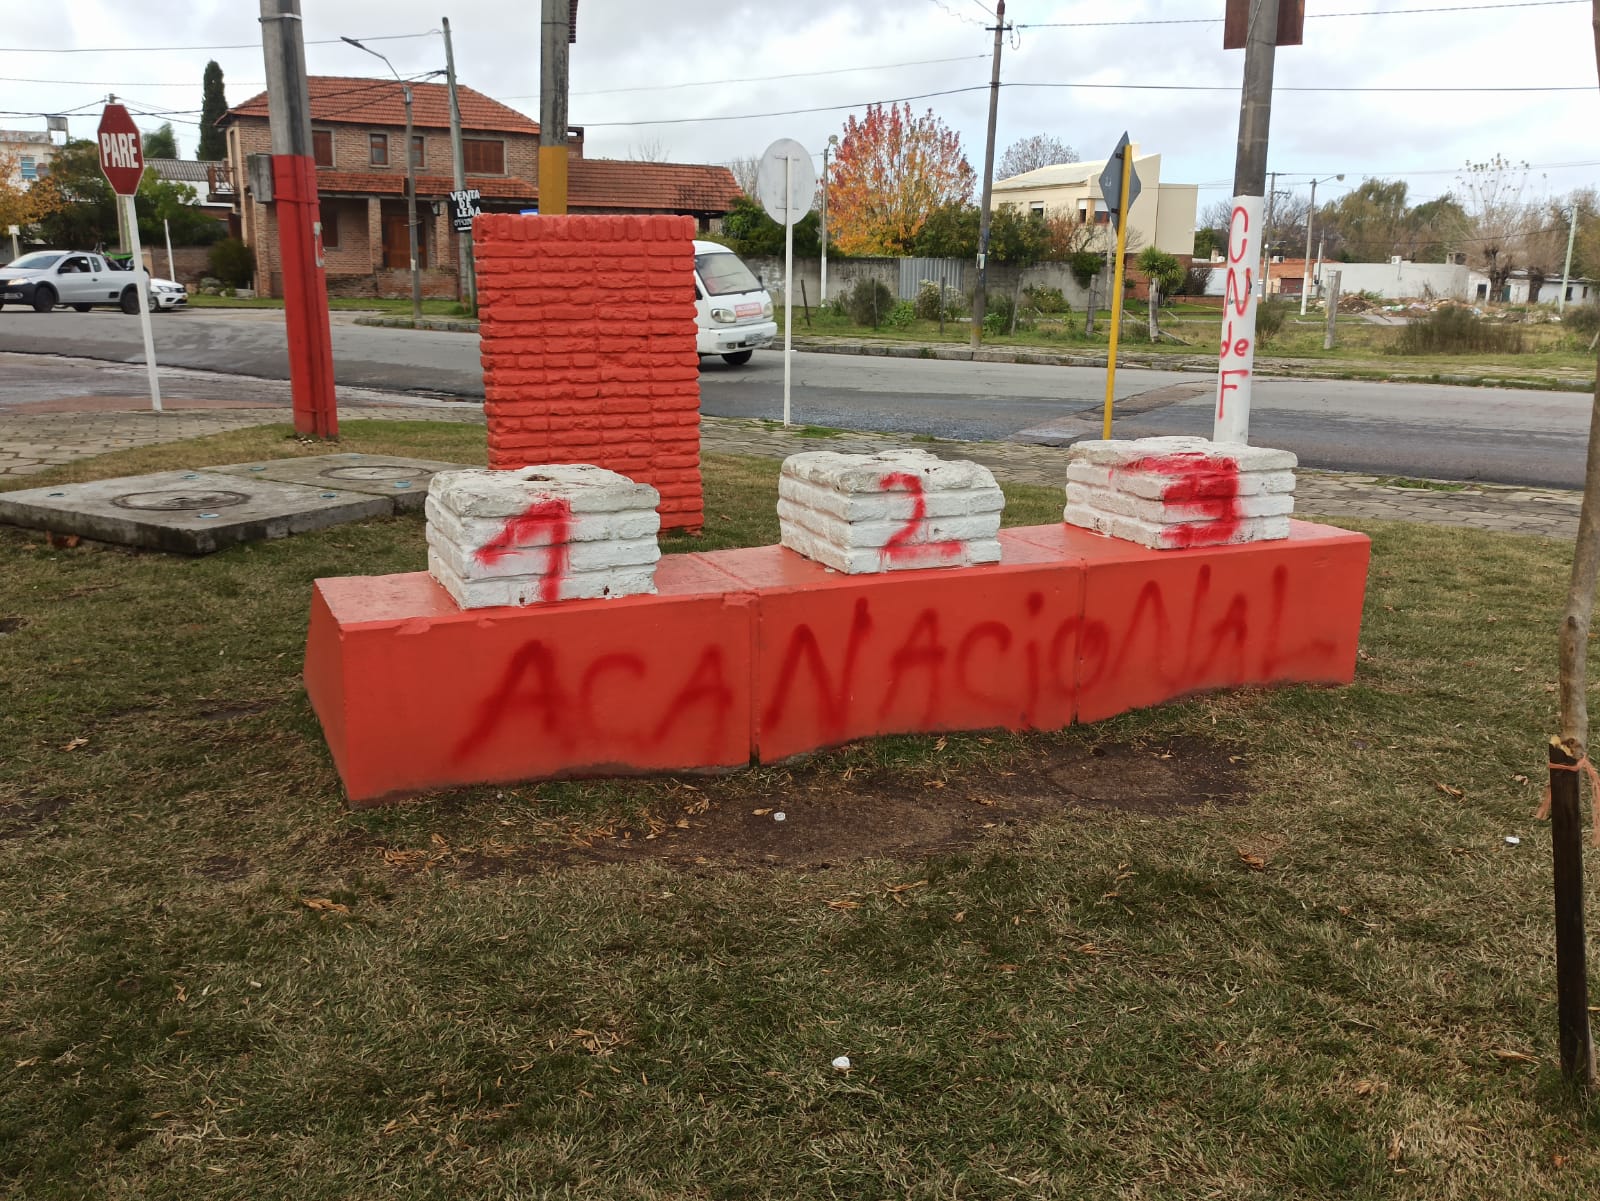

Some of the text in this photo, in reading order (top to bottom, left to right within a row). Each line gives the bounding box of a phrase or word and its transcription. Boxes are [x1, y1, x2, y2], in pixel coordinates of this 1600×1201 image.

[101, 133, 139, 168] PARE
[450, 190, 480, 201] VENTA
[459, 199, 472, 209] DE
[1218, 369, 1249, 420] F
[880, 471, 962, 561] 2
[474, 499, 572, 601] 1
